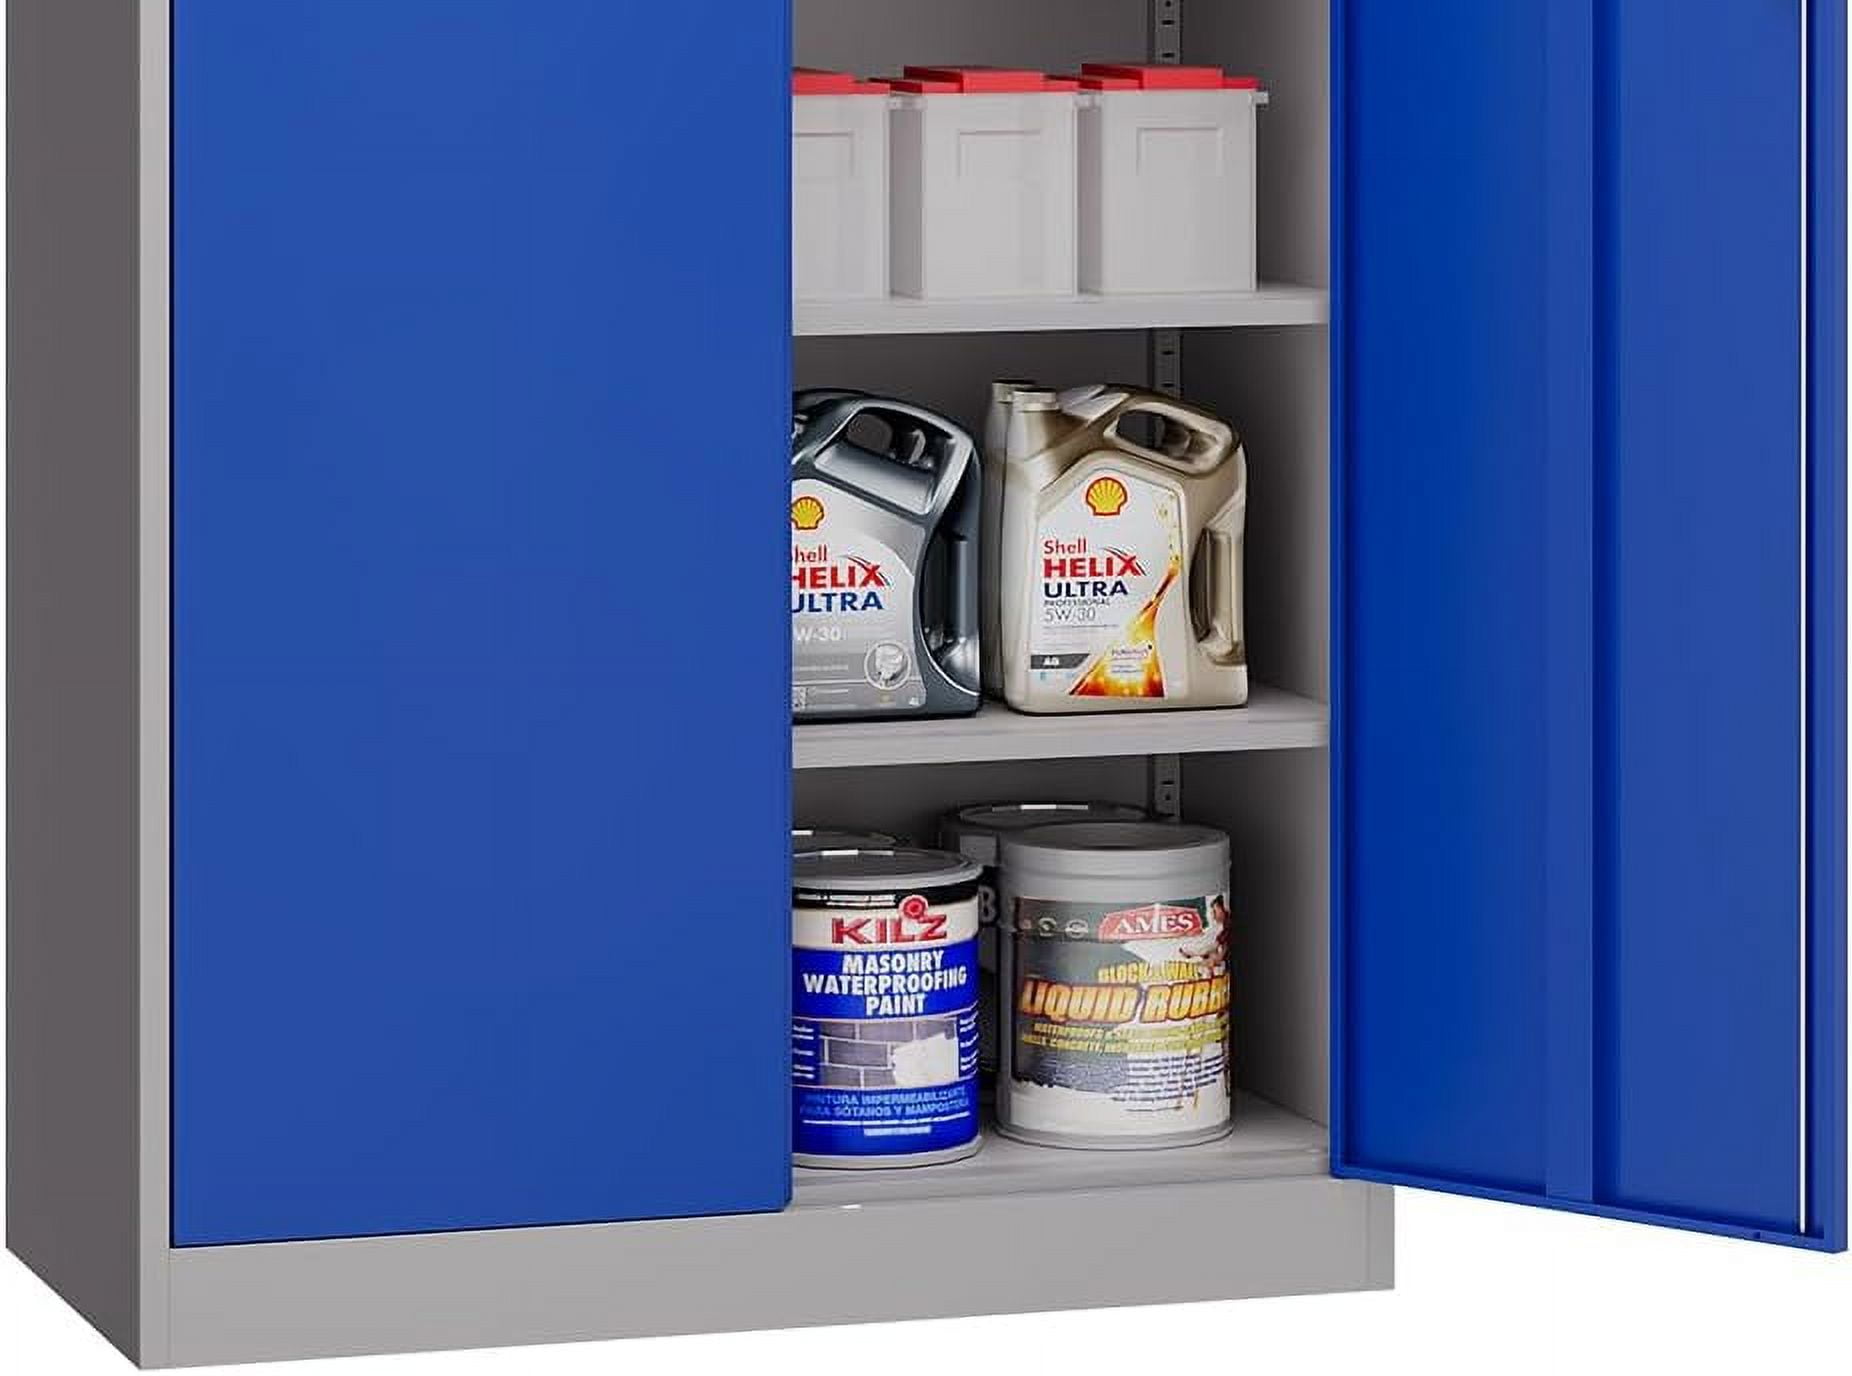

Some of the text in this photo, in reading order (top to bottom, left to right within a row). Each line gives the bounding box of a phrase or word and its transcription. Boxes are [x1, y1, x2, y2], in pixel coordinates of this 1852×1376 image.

[792, 543, 828, 563] hell
[1043, 537, 1087, 555] Shell
[1043, 555, 1142, 579] HELIX
[1043, 580, 1129, 599] ULTRA
[792, 625, 841, 643] W-30
[831, 912, 948, 945] KILZ
[1114, 913, 1194, 935] AMES
[841, 949, 945, 976] MASONRY
[802, 966, 968, 997] WATERPROOFING
[864, 993, 928, 1016] PAINT
[1022, 974, 1229, 1023] LIQUID RUBB
